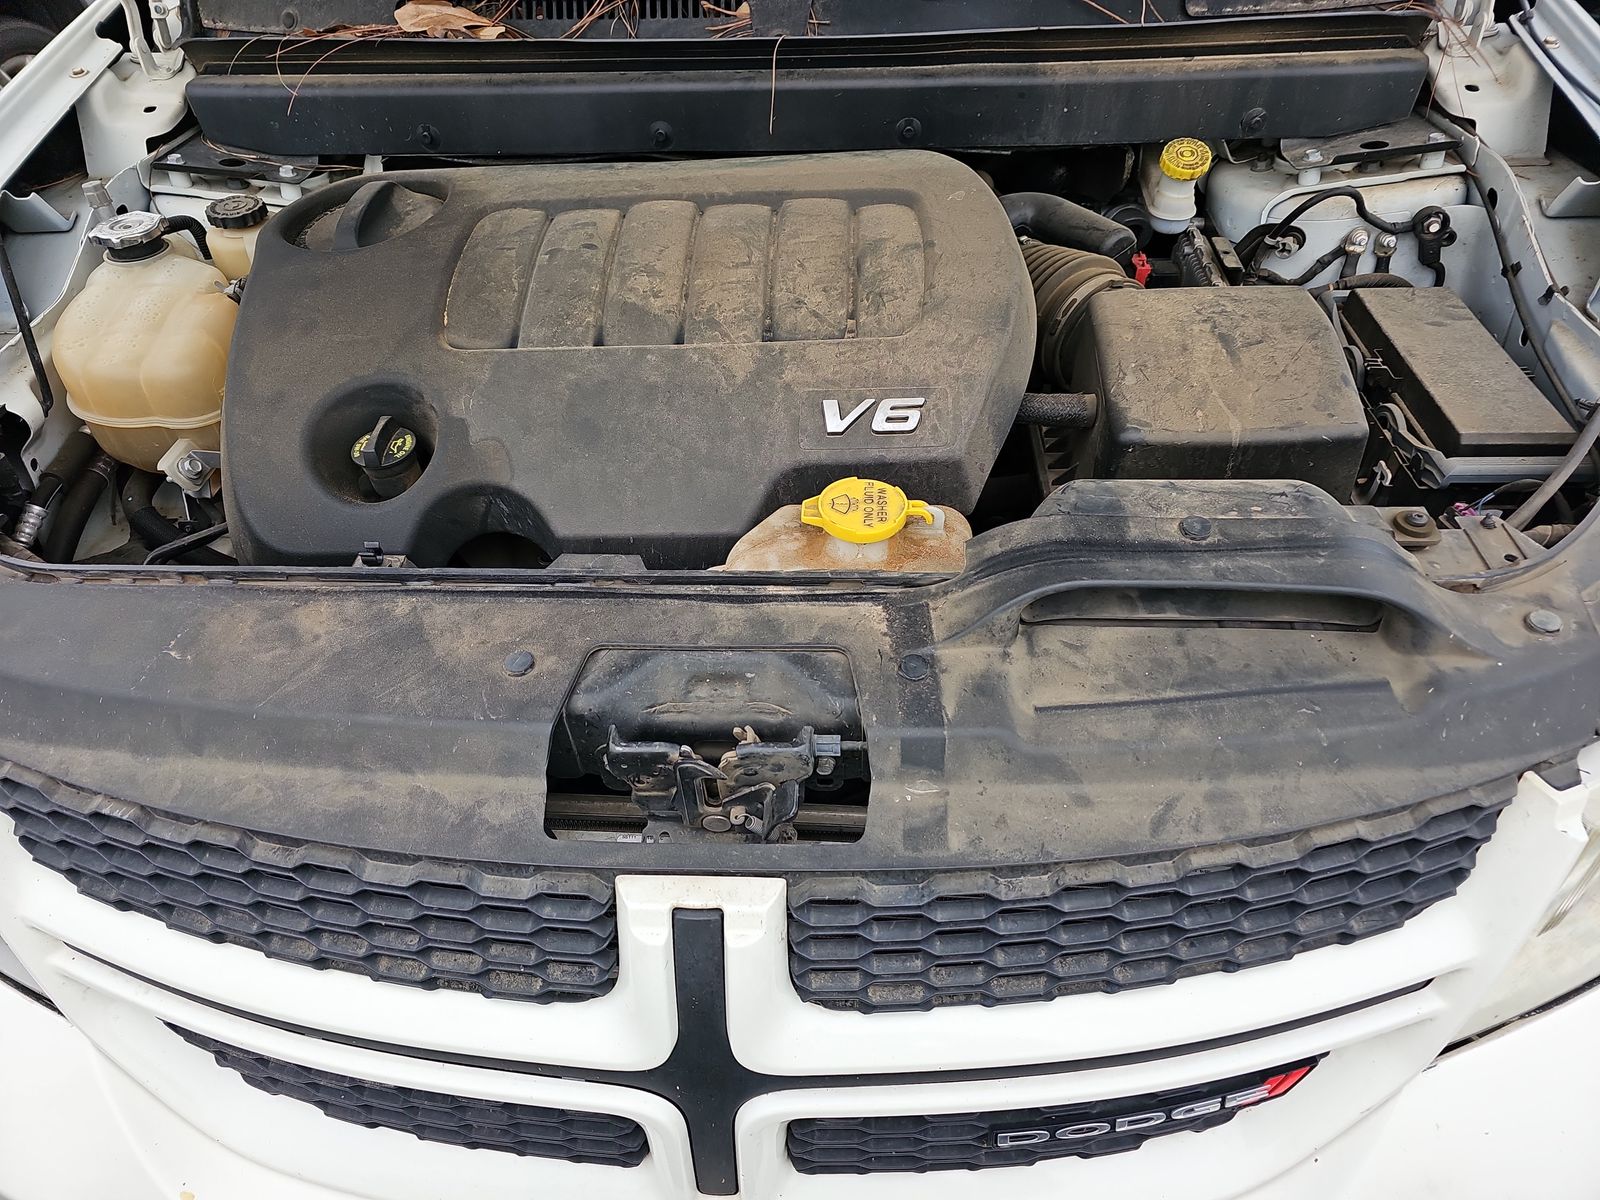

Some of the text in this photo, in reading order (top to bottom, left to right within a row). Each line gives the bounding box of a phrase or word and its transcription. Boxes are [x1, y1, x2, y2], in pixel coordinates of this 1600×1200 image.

[822, 398, 927, 436] V6
[393, 450, 406, 459] OIL
[863, 481, 875, 529] FLUID ONLY
[876, 487, 888, 524] WASHER
[996, 1083, 1272, 1147] DODGE
